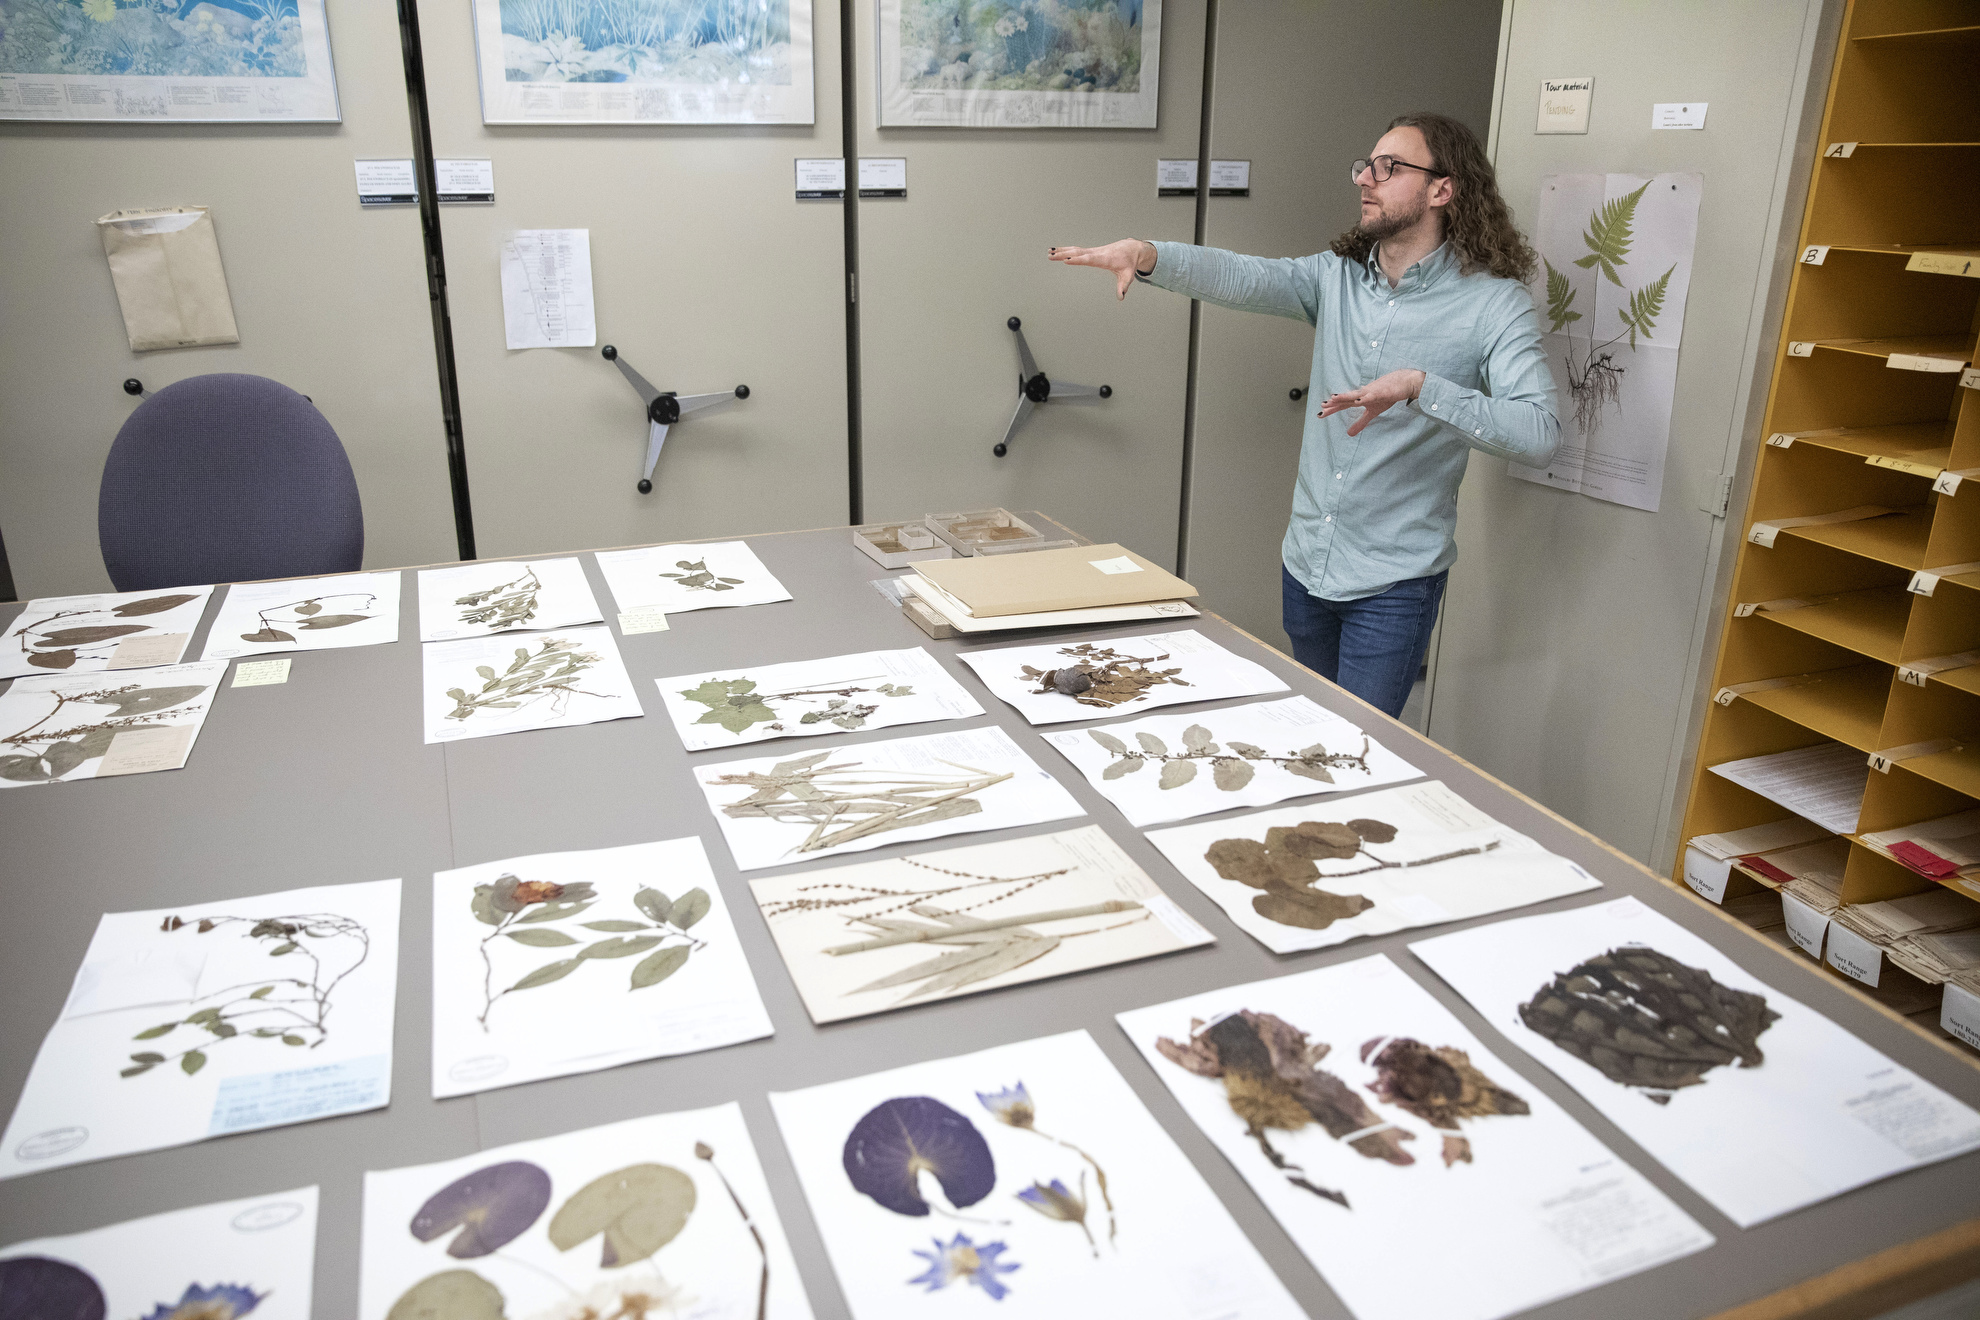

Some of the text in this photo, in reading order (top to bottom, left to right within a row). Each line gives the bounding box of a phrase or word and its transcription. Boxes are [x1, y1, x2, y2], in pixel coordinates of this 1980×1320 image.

[1545, 81, 1589, 91] Tour Material
[1829, 144, 1844, 158] A
[1805, 249, 1819, 263] B
[1793, 342, 1803, 355] C
[1773, 435, 1785, 446] D
[1938, 480, 1950, 493] K
[1753, 532, 1764, 543] E
[1912, 578, 1927, 594] L
[1740, 604, 1752, 616] F
[1904, 670, 1920, 686] M
[1718, 691, 1731, 705] G
[1873, 757, 1885, 770] N
[1698, 879, 1715, 892] Range
[1797, 931, 1812, 945] Range
[1833, 952, 1868, 976] Sort Range
[1837, 963, 1861, 979] 146-179
[1949, 1016, 1964, 1031] Sort
